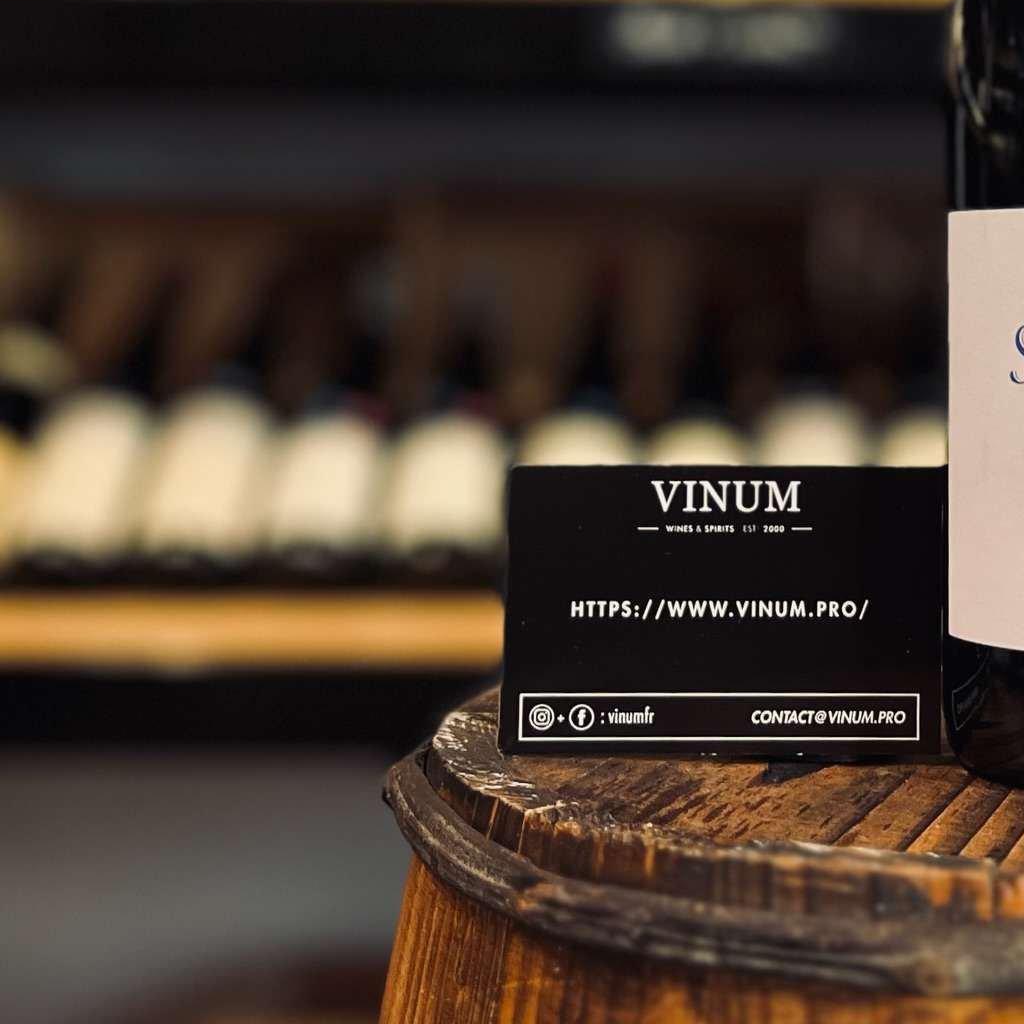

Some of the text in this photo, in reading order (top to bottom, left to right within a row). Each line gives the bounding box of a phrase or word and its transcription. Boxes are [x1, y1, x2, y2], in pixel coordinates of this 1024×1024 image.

[651, 480, 802, 513] VINUM
[665, 524, 694, 533] WINES
[695, 524, 702, 533] &
[704, 524, 735, 533] SPIRITS
[763, 524, 785, 533] 2000
[570, 599, 869, 620] HTTPS://WWW.VINUM.PRO/
[751, 709, 906, 725] CONTACT@VINUM.PRO
